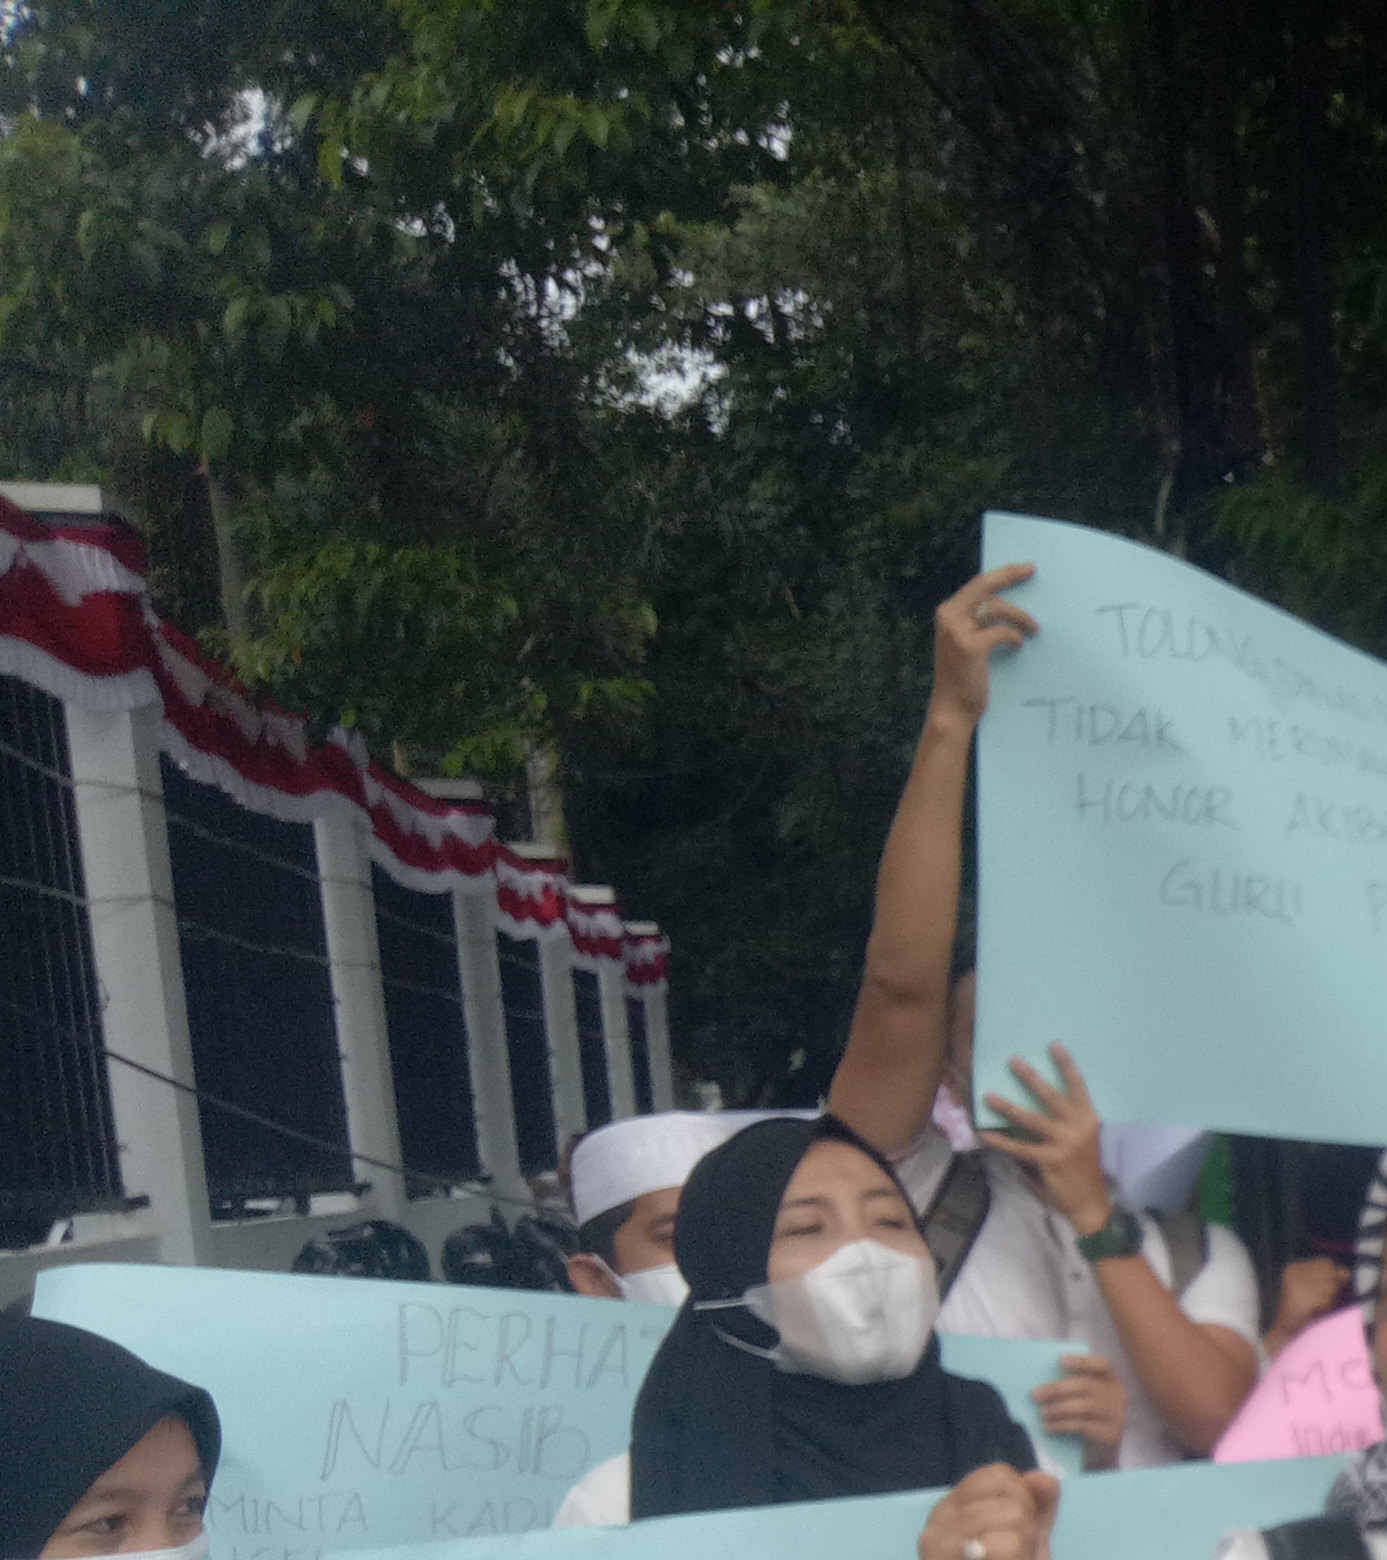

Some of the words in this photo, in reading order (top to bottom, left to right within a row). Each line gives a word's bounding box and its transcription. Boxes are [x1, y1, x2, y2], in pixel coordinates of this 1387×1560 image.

[1024, 697, 1184, 752] TIDAK
[1075, 772, 1240, 830] HONOR
[1157, 858, 1304, 922] GURU
[320, 1398, 592, 1481] NASIB
[208, 1491, 369, 1534] MINTA
